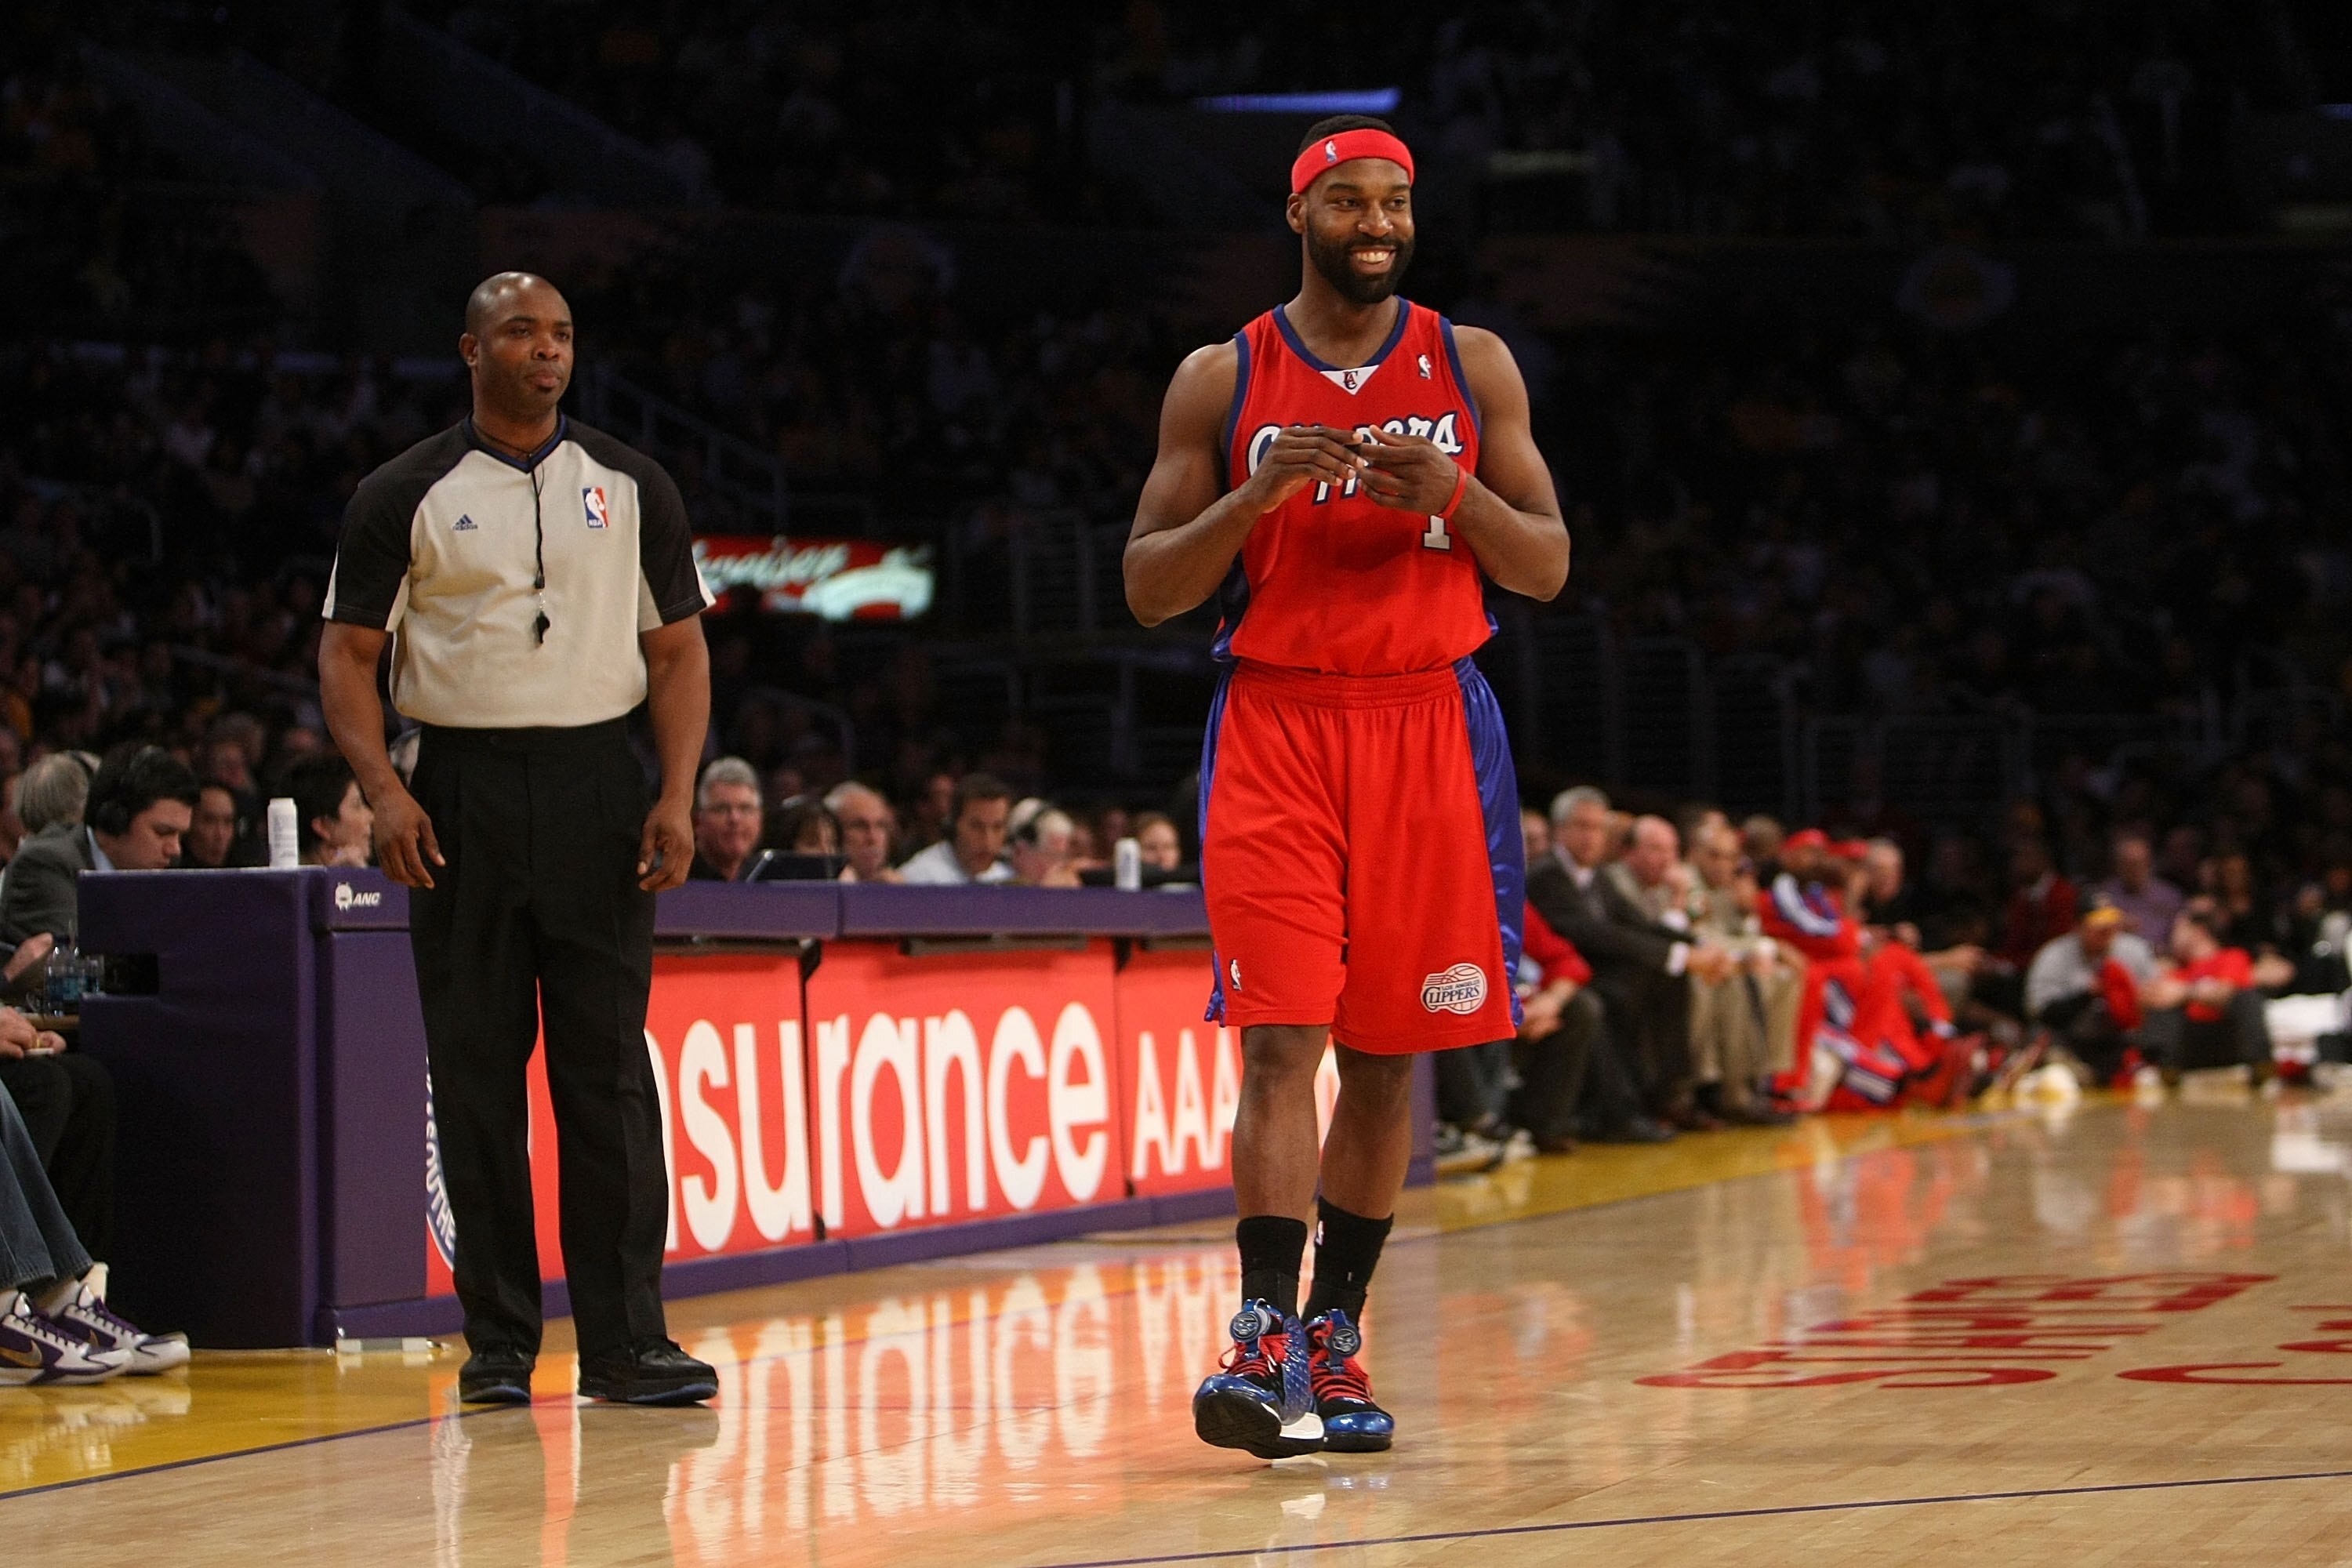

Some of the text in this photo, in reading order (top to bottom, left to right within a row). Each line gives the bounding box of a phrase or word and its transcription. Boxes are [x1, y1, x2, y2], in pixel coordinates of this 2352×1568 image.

[1247, 412, 1464, 503] Cers
[452, 523, 478, 532] adidas
[588, 518, 602, 527] NBA
[1423, 985, 1480, 1011] CLIPPERS
